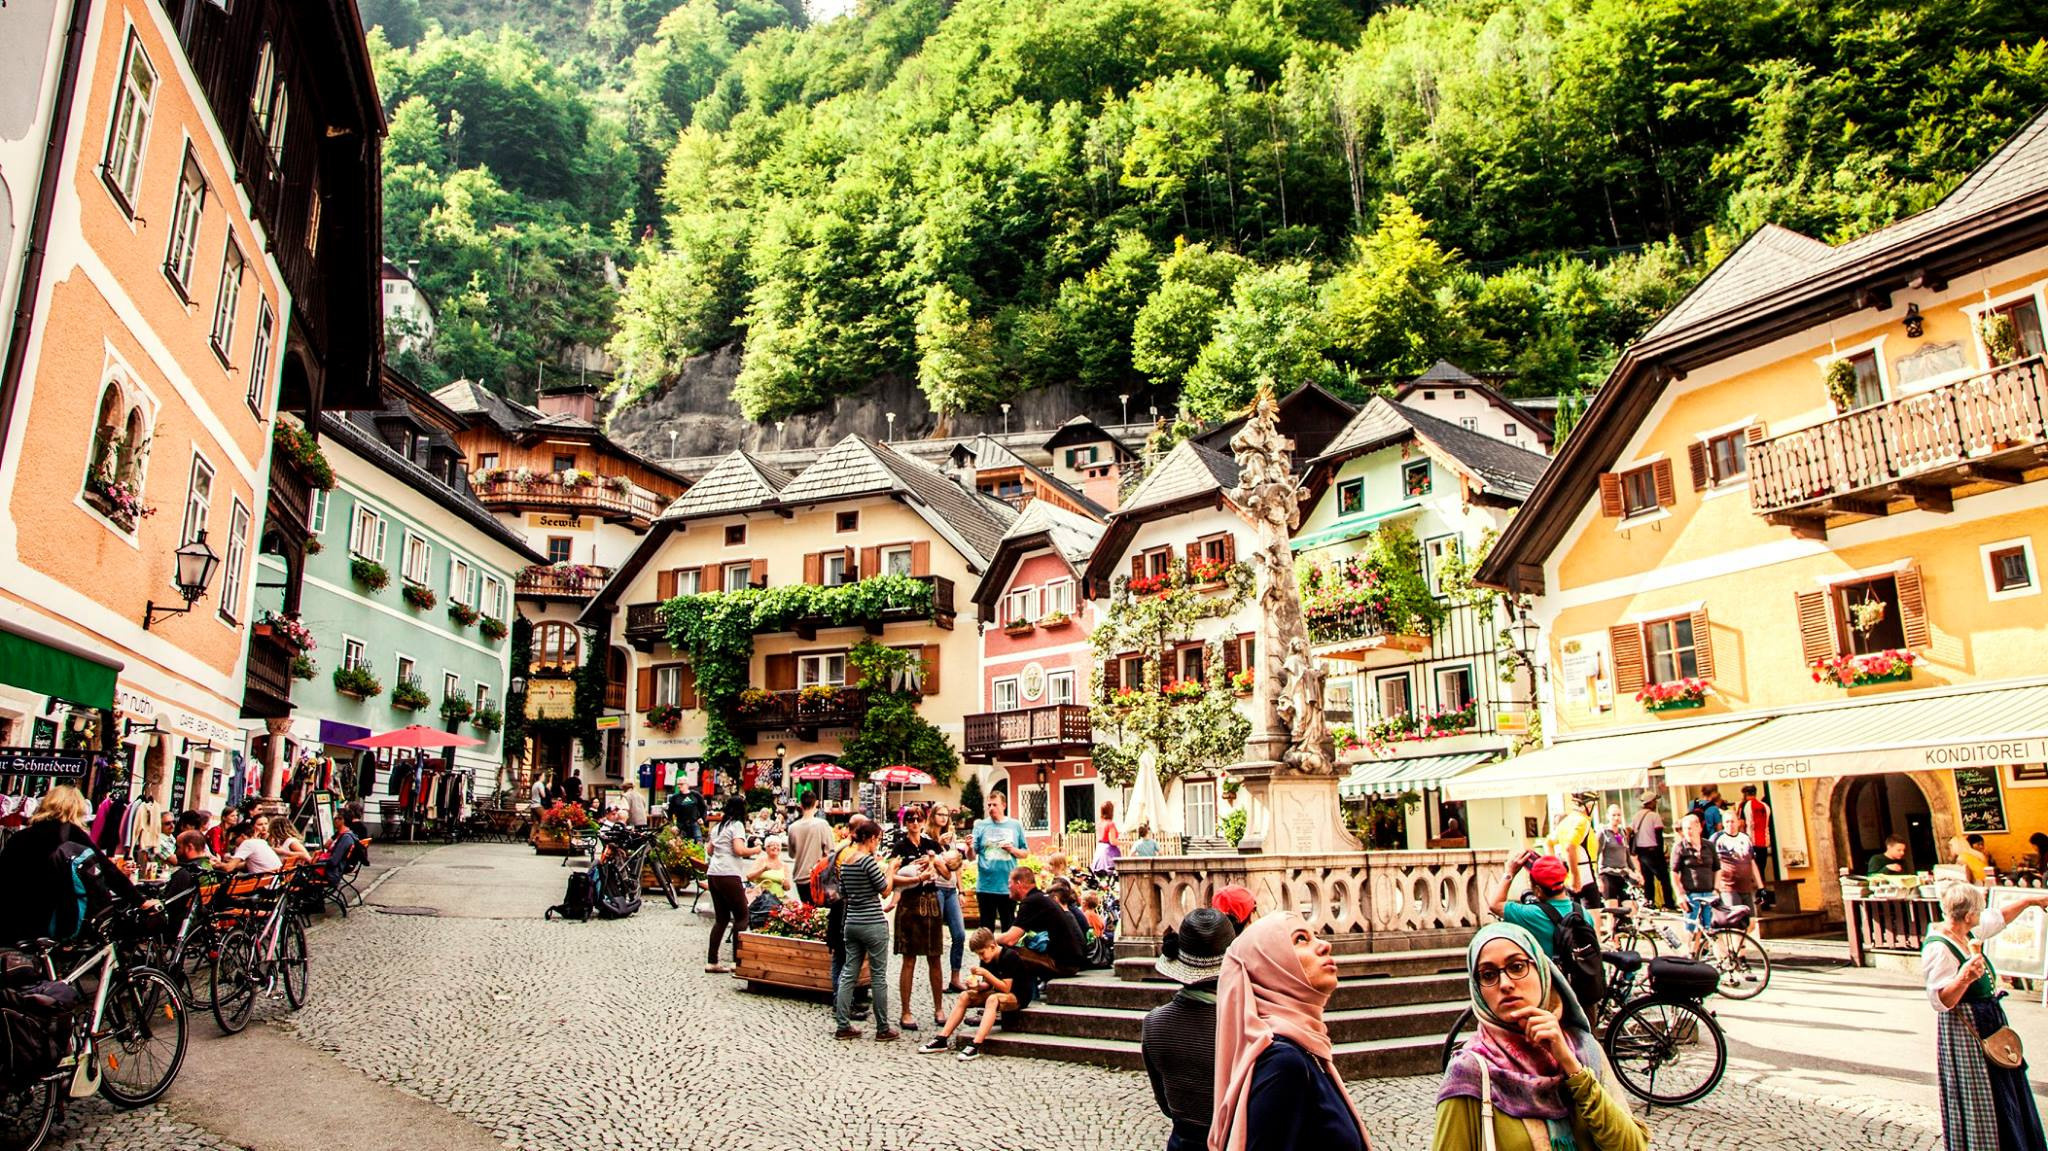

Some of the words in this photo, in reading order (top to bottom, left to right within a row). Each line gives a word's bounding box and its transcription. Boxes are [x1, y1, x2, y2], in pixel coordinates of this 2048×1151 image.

[540, 515, 581, 528] Seewirt
[1925, 742, 2029, 764] KONDITOREI
[12, 758, 81, 773] Schneiderei
[1718, 763, 1756, 778] café
